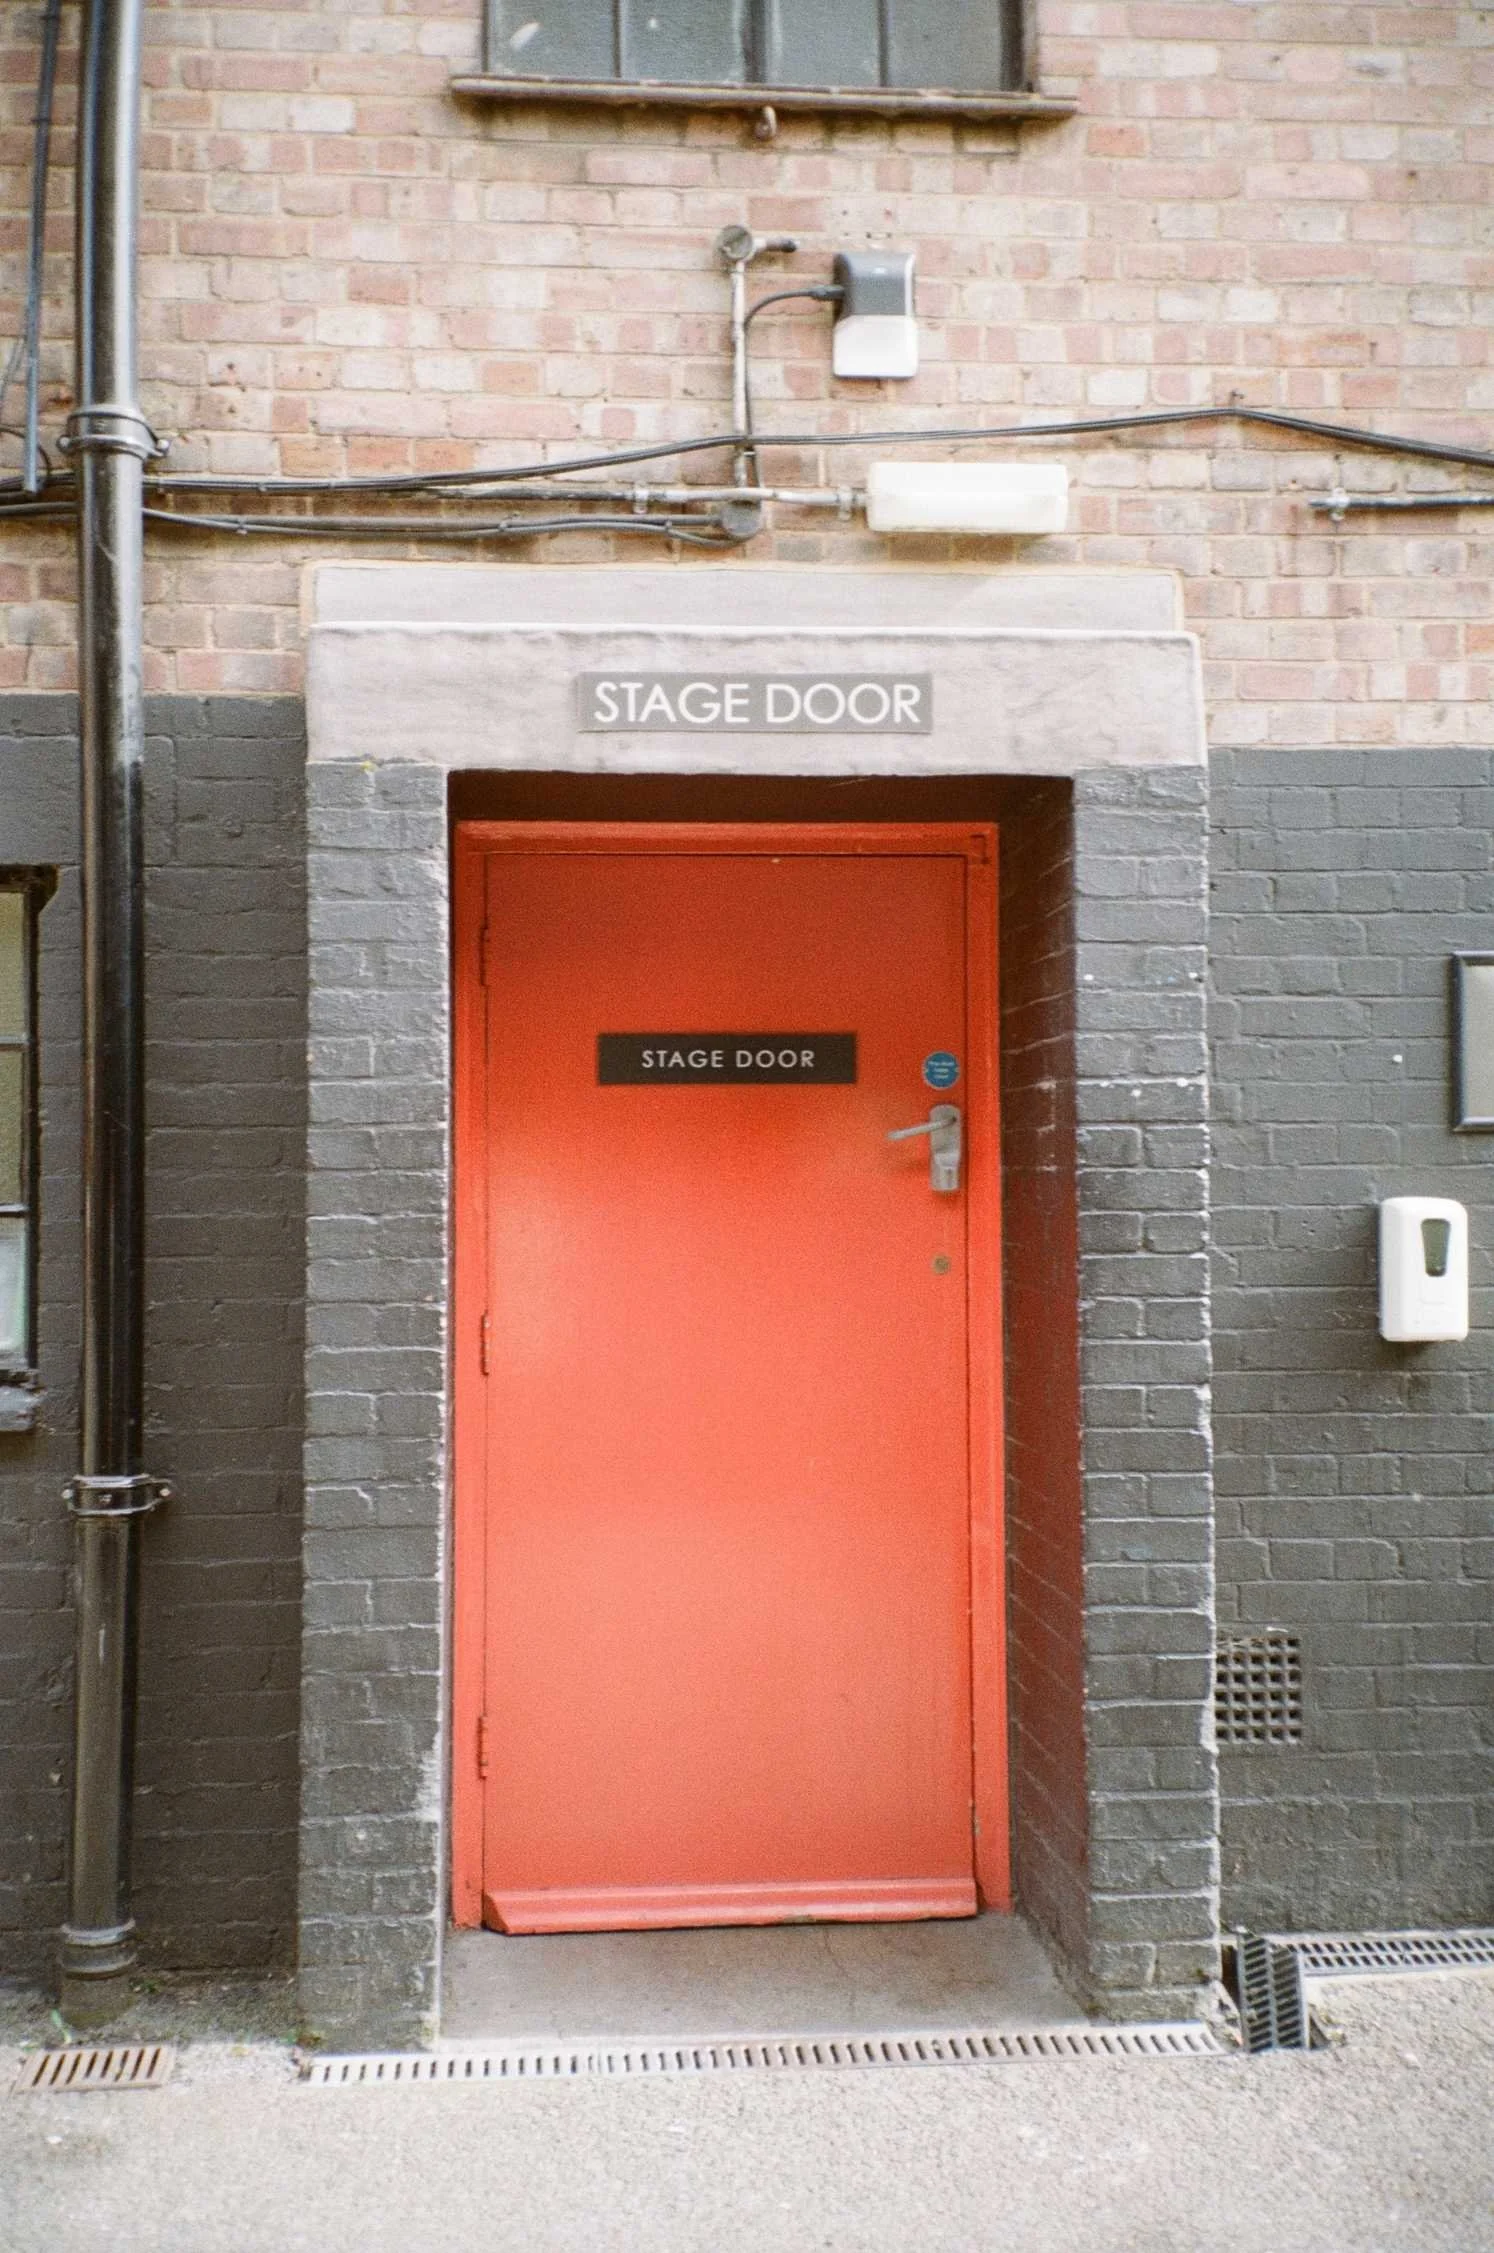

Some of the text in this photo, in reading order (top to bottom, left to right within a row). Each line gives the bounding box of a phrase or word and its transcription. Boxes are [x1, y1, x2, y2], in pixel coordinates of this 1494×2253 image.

[594, 682, 922, 724] STAGE DOOR
[641, 1050, 815, 1068] STAGE DOOR
